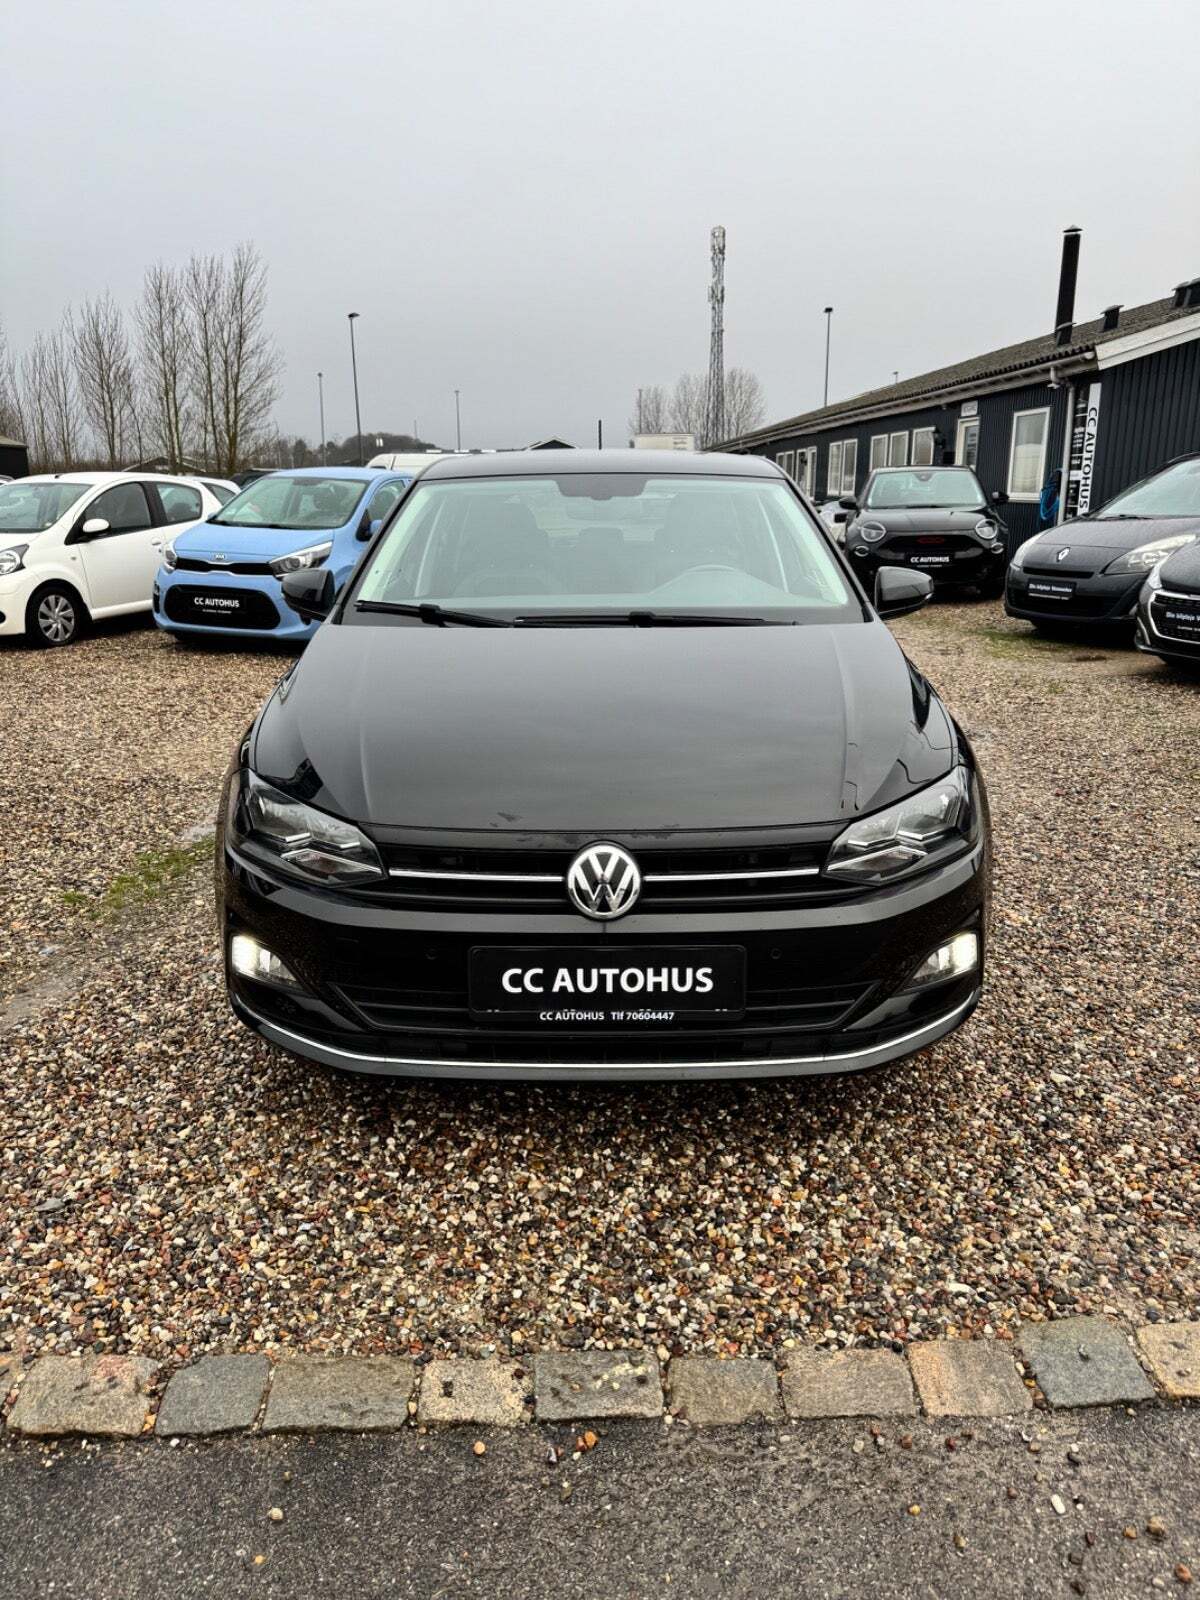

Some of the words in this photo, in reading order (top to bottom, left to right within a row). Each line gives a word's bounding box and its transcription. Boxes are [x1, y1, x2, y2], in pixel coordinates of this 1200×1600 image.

[1087, 407, 1098, 427] CC
[1079, 432, 1096, 509] AUTOHUS
[194, 597, 204, 606] CC
[204, 598, 240, 608] AUTOHUS
[502, 967, 544, 994] CC
[551, 966, 714, 994] AUTOHUS
[539, 1011, 554, 1021] CC
[554, 1011, 605, 1021] AUTOHUS
[610, 1010, 625, 1021] Tlf
[625, 1011, 675, 1021] 70604447
